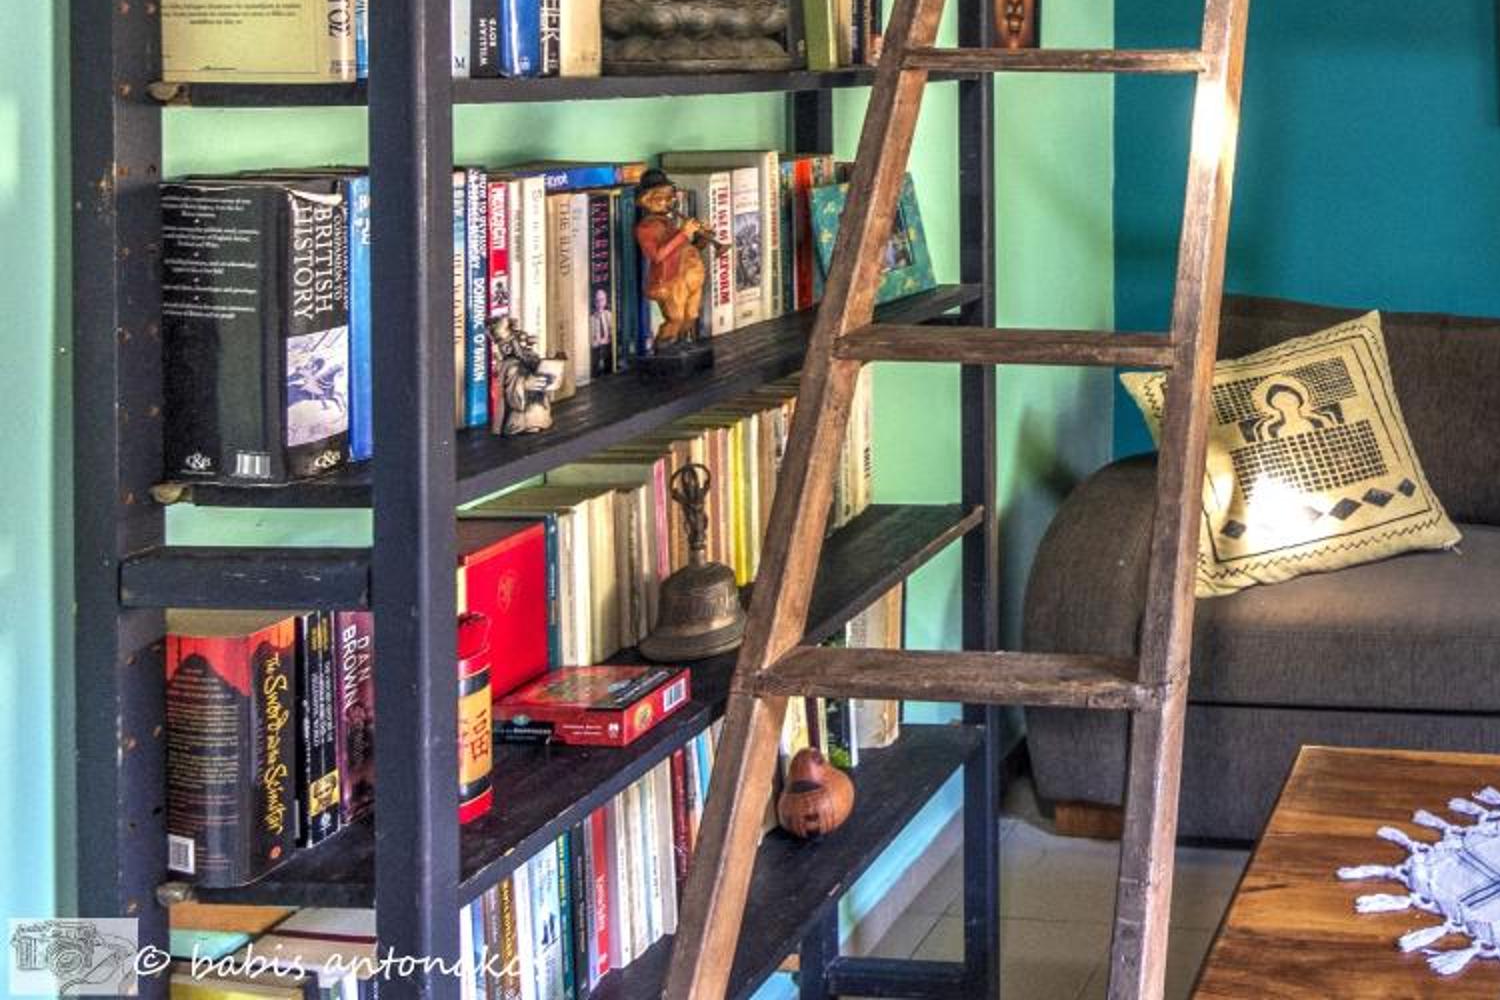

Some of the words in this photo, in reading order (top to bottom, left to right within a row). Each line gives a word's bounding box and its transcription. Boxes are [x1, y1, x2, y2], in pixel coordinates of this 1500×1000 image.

[559, 202, 570, 231] THE
[293, 205, 315, 320] HISTORY
[313, 205, 333, 314] BRITISH
[342, 625, 359, 709] BROWN
[357, 635, 371, 682] DAN
[263, 674, 289, 730] Sword
